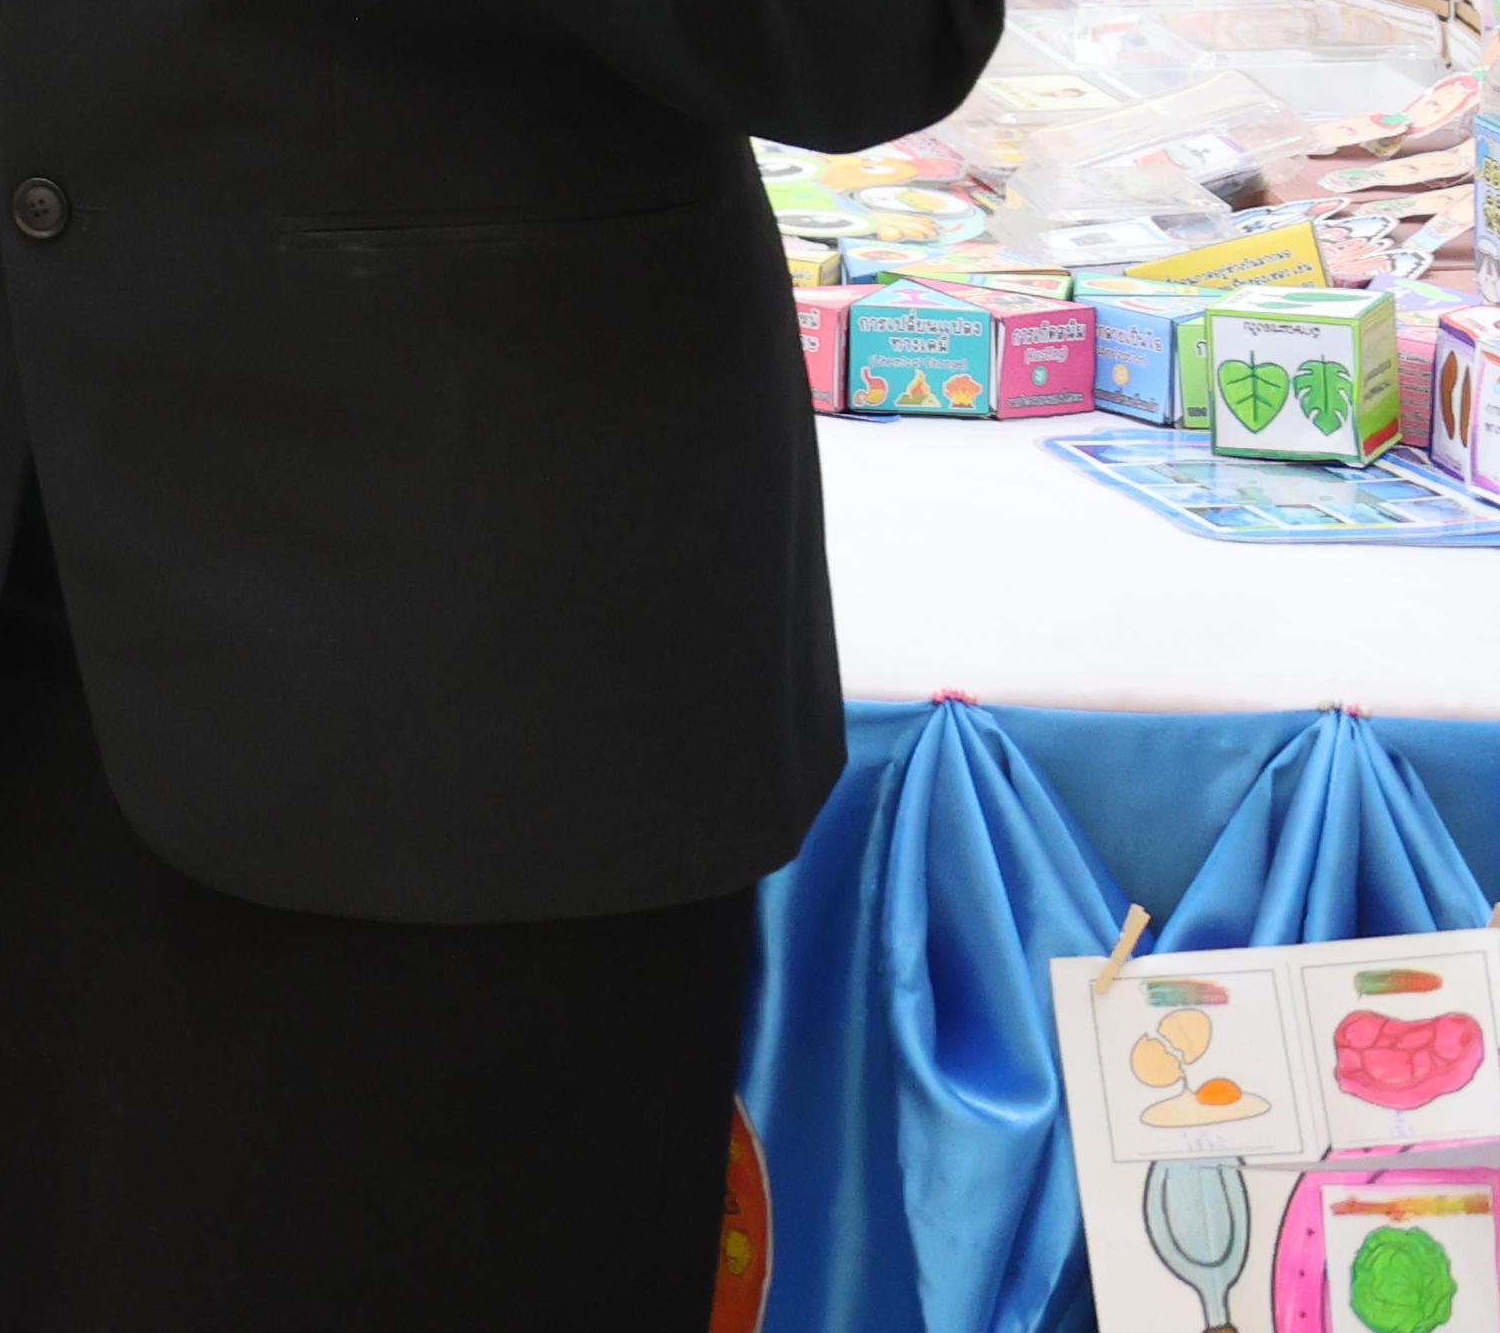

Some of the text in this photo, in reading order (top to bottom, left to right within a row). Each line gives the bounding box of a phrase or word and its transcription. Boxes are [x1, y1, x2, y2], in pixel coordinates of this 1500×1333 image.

[857, 309, 983, 338] การเปลี่ยนแปลง
